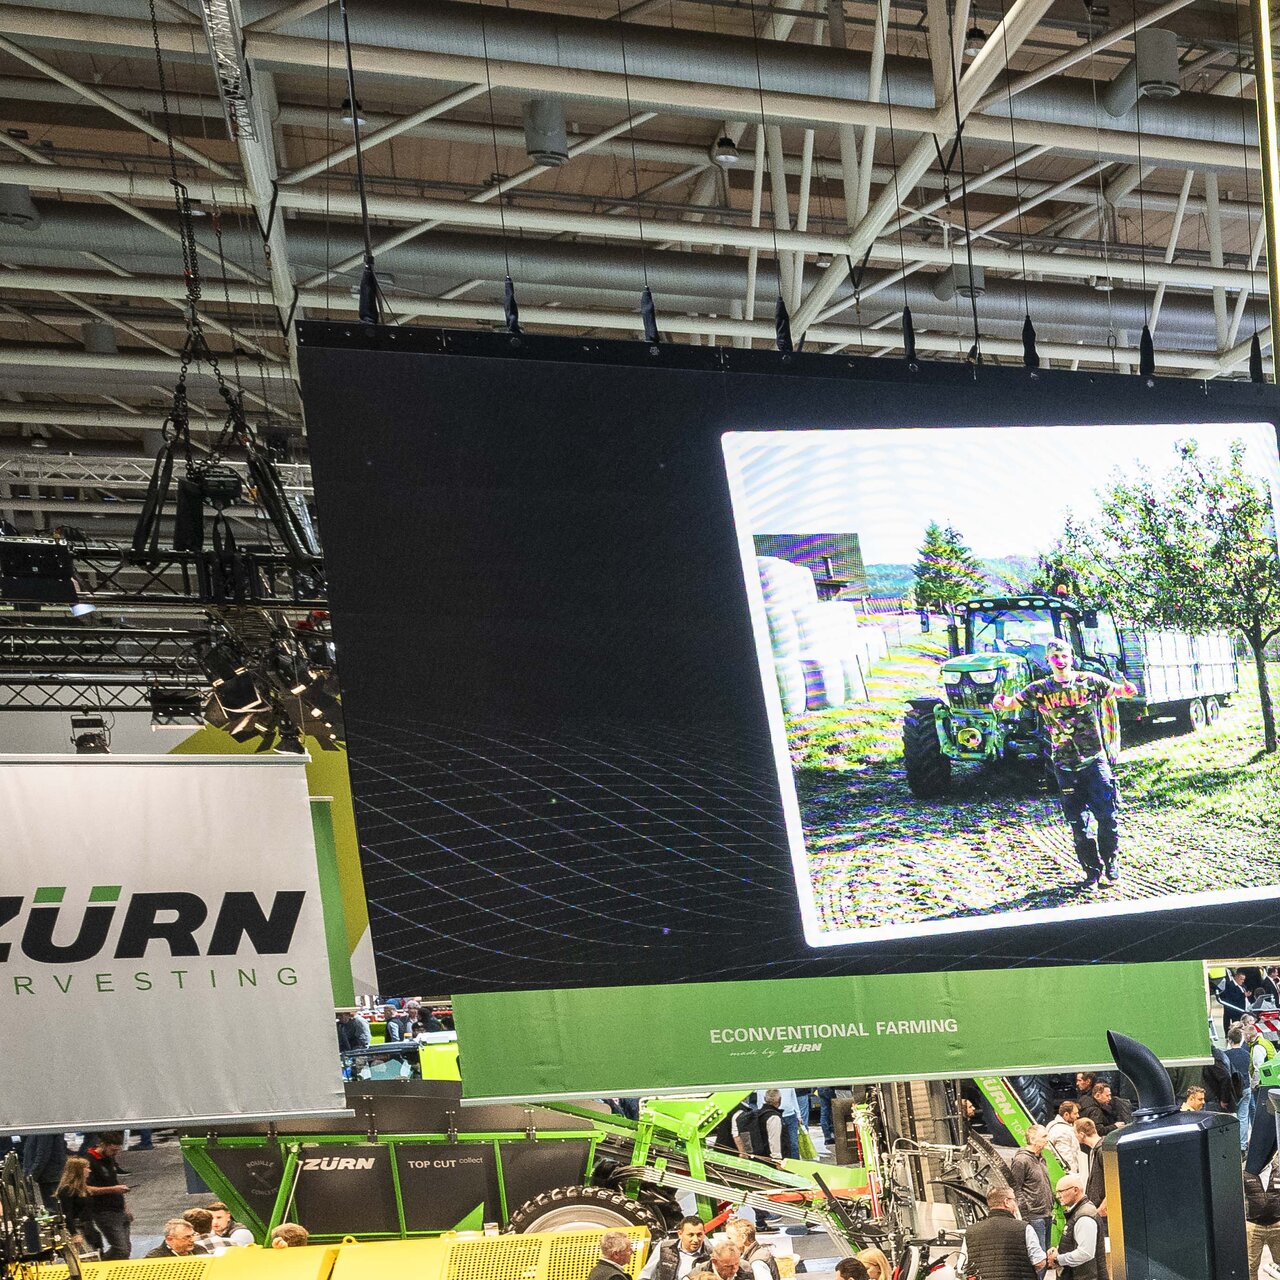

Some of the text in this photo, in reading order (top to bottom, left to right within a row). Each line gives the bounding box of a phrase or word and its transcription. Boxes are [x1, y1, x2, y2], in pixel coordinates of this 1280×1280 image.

[0, 885, 307, 964] ÜRN
[710, 1018, 958, 1044] ECONVENTIONAL FARMING
[783, 1043, 822, 1054] ZÜRN
[302, 1156, 376, 1171] ZÜRN
[407, 1156, 484, 1169] TOP CUT collect
